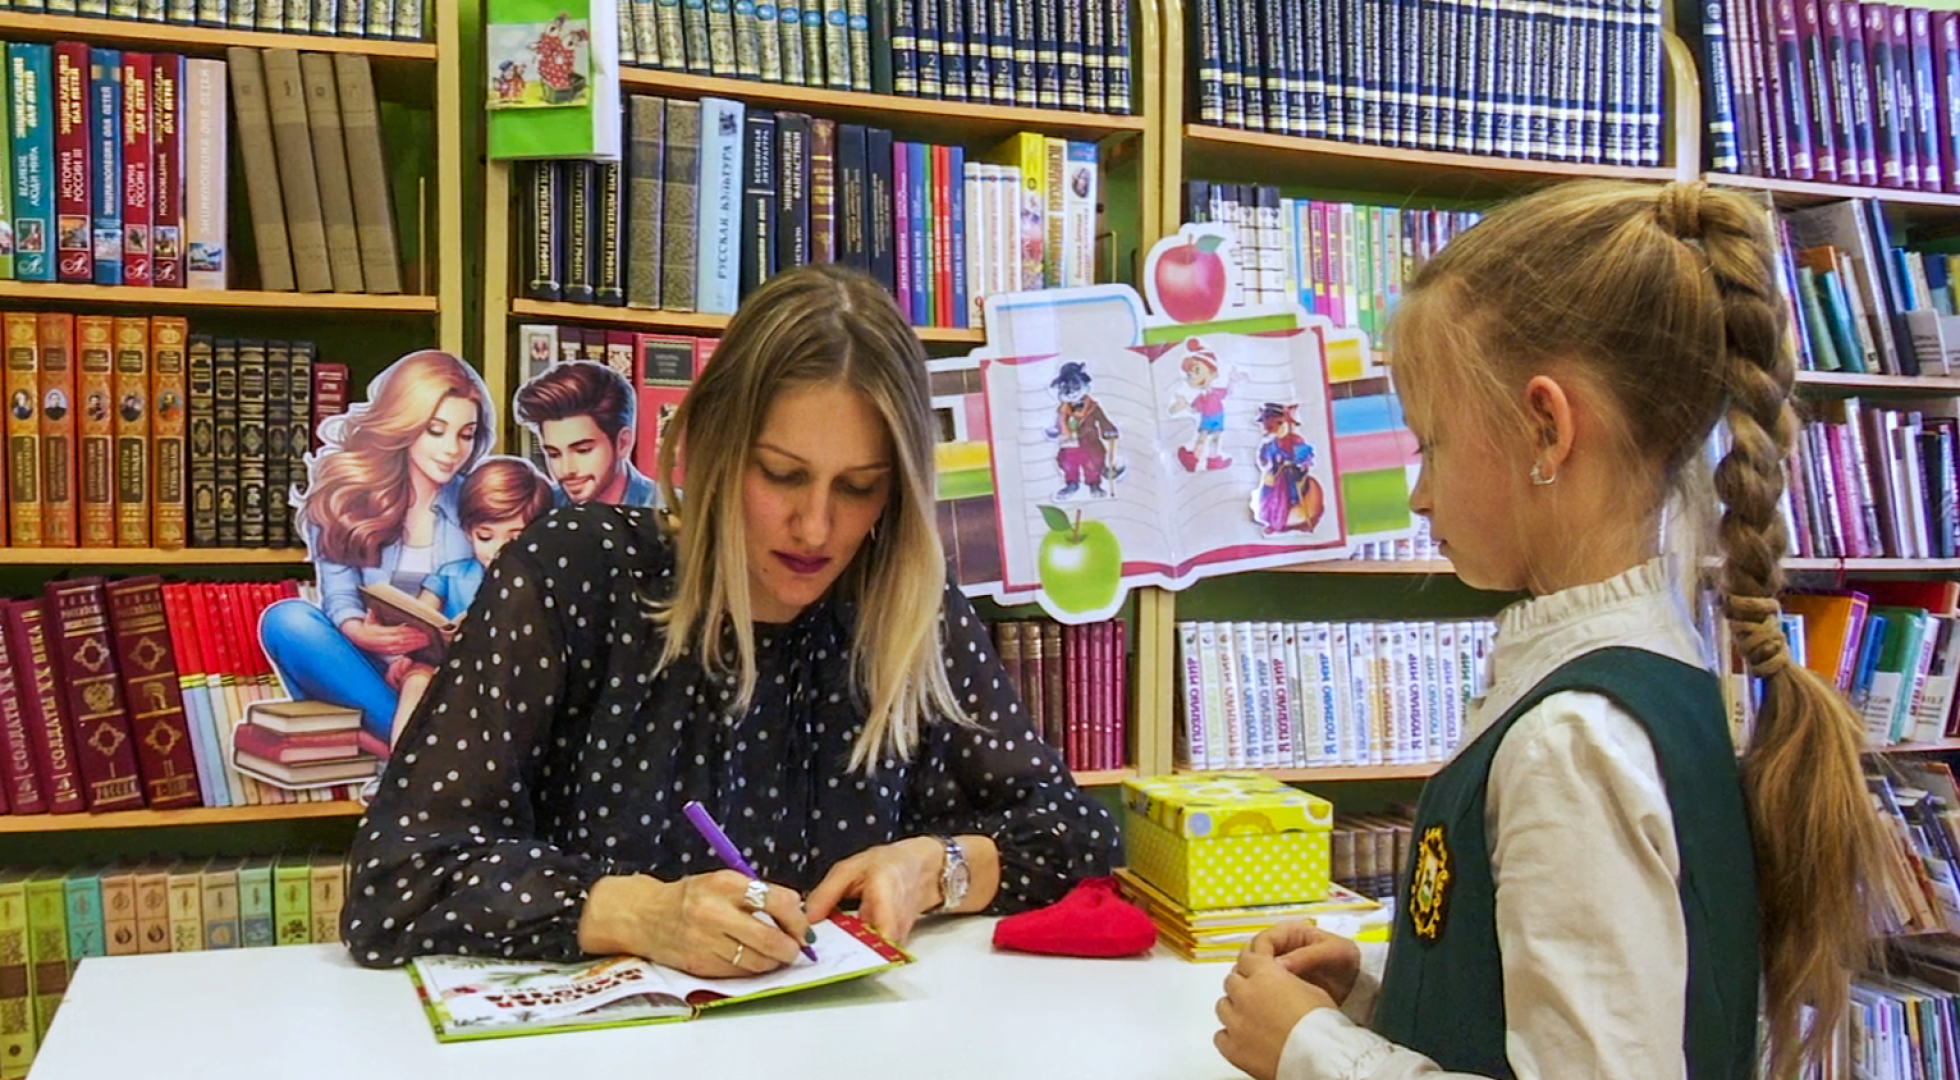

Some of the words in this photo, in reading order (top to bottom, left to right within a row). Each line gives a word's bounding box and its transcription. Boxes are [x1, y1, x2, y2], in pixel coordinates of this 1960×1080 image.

[928, 54, 936, 66] 2
[977, 56, 986, 70] 4
[1000, 60, 1008, 73] 5
[1023, 63, 1031, 76] 6
[1069, 65, 1078, 78] 8
[69, 68, 82, 101] ДЕТЕЙ
[134, 78, 146, 111] ДЕТЕЙ
[163, 78, 174, 111] ДЕТЕЙ
[199, 68, 212, 106] ДЕТЕЙ
[71, 102, 83, 124] ДЛЯ
[100, 86, 112, 116] ДЕТЕЙ
[101, 118, 112, 138] ДЛЯ
[135, 113, 146, 134] ДЛЯ
[164, 113, 175, 134] ДЛЯ
[200, 109, 211, 134] ДЛЯ
[28, 146, 40, 172] МИРА
[754, 129, 763, 184] ВСЕМИРНАЯ
[761, 129, 771, 185] ЛИТЕРАТУРА
[783, 131, 793, 211] ЭНЦИКЛОПЕДИЯ
[792, 131, 803, 199] ФАНТАСТИКИ
[17, 155, 29, 198] ВЕЛИКИЕ
[61, 151, 73, 198] ИСТОРИЯ
[73, 160, 84, 202] РОССИИ
[127, 164, 137, 206] ИСТОРИЯ
[136, 171, 146, 208] РОССИИ
[200, 137, 213, 235] ЭНЦИКЛОПЕДИЯ
[718, 145, 732, 212] КУЛЬТУРА
[29, 176, 41, 207] ЛЮДИ
[540, 233, 550, 242] И
[605, 241, 615, 249] И
[717, 218, 730, 280] РУССКАЯ
[540, 243, 550, 276] МИФЫ
[605, 251, 616, 283] МИФЫ
[28, 625, 48, 664] ВЕКА
[35, 666, 54, 695] XX
[1186, 658, 1199, 685] МИР
[1221, 653, 1233, 683] МИР
[1240, 654, 1252, 683] МИР
[1257, 659, 1268, 687] МИР
[1272, 659, 1285, 685] МИР
[1319, 653, 1330, 683] МИР
[1408, 653, 1418, 681] МИР
[1442, 659, 1454, 685] МИР
[1460, 652, 1471, 681] МИР
[1189, 688, 1202, 742] ПОЗНАЮ
[1224, 686, 1239, 744] ПОЗНАЮ
[1242, 688, 1257, 744] ПОЗНАЮ
[1259, 689, 1272, 742] ПОЗНАЮ
[1275, 688, 1288, 740] ПОЗНАЮ
[1322, 685, 1336, 741] ПОЗНАЮ
[1409, 683, 1421, 738] ПОЗНАЮ
[1445, 687, 1456, 738] ПОЗНАЮ
[3, 696, 29, 770] СОЛДАТЫ
[41, 696, 68, 770] СОЛДАТЫ
[1277, 743, 1291, 753] Я
[1411, 740, 1422, 750] Я
[1446, 740, 1457, 750] Я
[1191, 745, 1204, 755] Я
[1228, 746, 1241, 758] Я
[1246, 747, 1259, 758] Я
[1262, 744, 1274, 755] Я
[1324, 744, 1337, 755] Я
